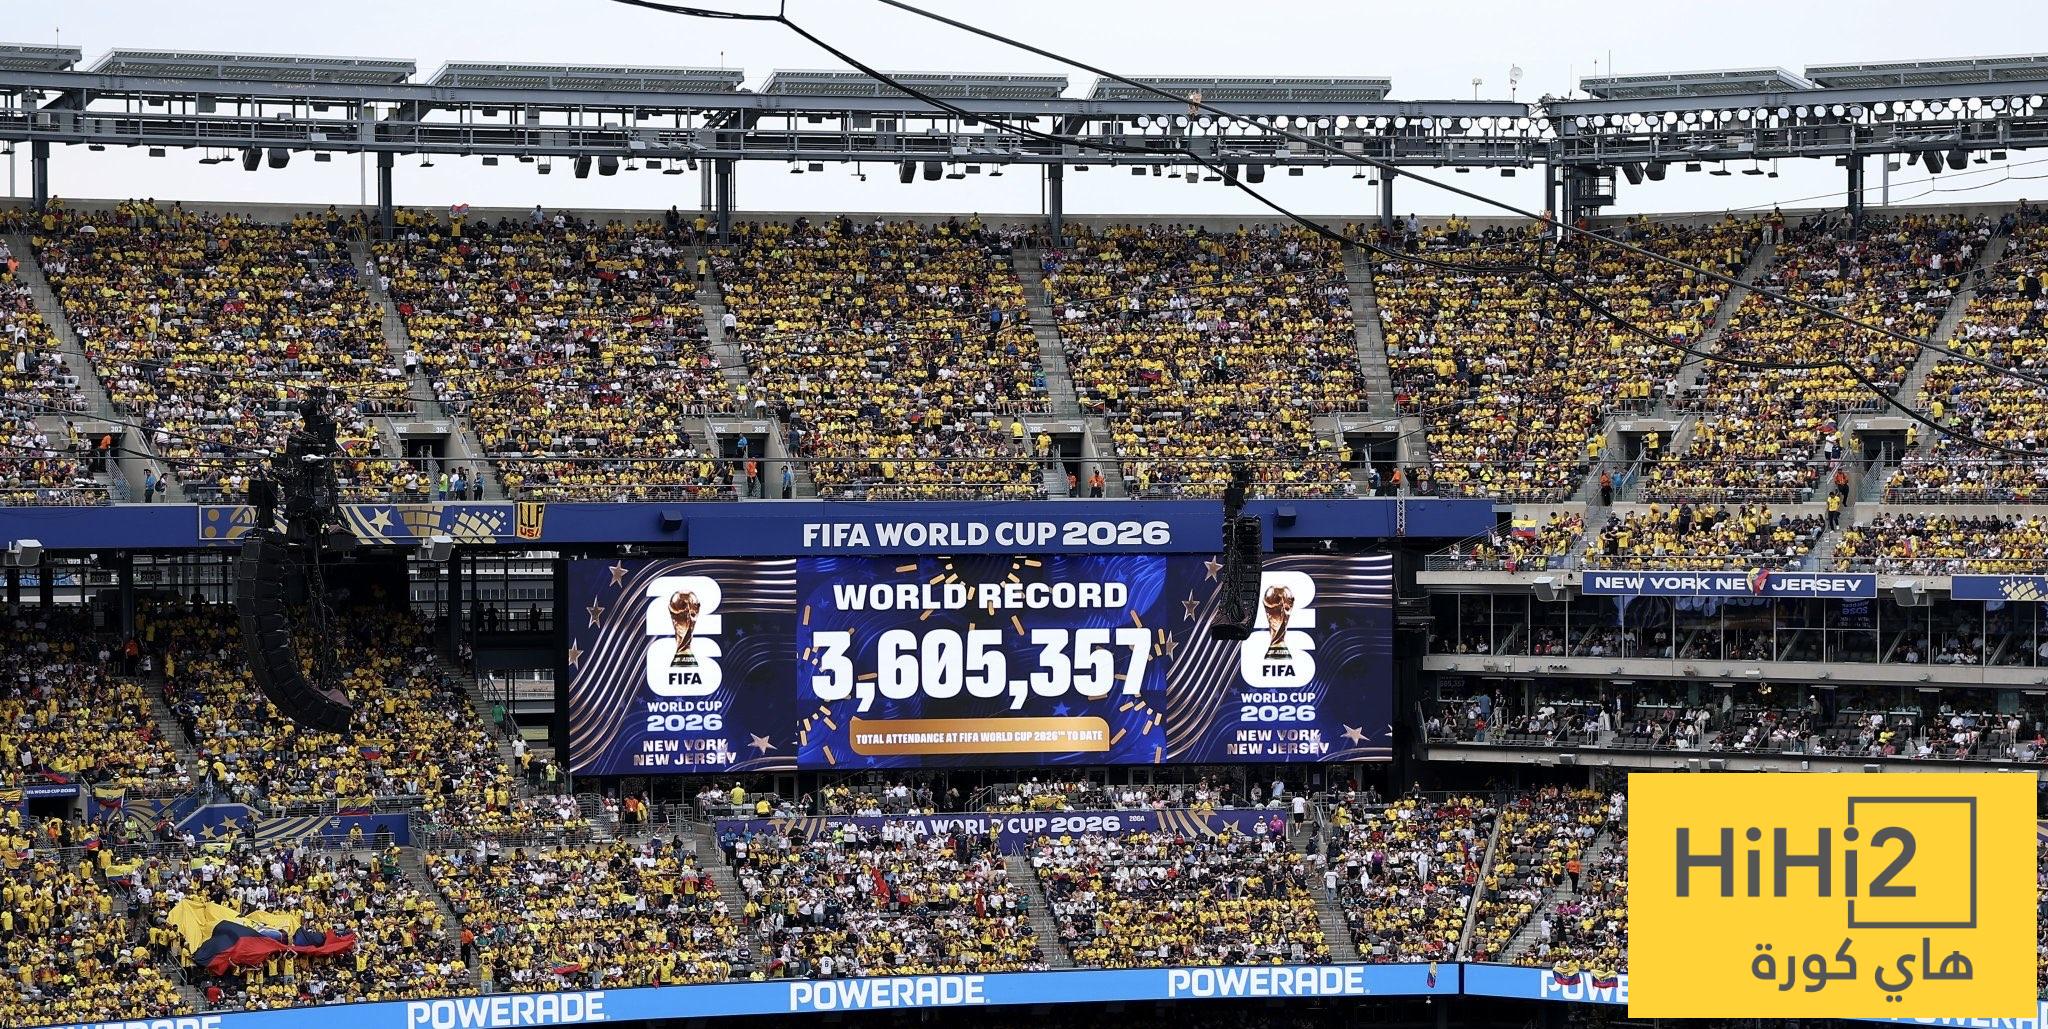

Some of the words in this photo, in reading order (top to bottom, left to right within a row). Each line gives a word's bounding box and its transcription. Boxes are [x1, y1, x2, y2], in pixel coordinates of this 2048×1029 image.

[803, 523, 871, 547] FIFA
[875, 522, 989, 547] WORLD
[994, 521, 1057, 546] CUP
[1062, 521, 1171, 545] 2026
[1595, 577, 1644, 590] NEW
[1650, 577, 1711, 590] YORK
[1771, 579, 1861, 592] JERSEY
[833, 583, 967, 611] WORLD
[979, 582, 1128, 609] RECORD
[812, 628, 1152, 713] 3,605,357
[1262, 665, 1296, 677] FIFA
[668, 673, 702, 685] FIFA
[1241, 693, 1287, 703] WORLD
[1290, 692, 1316, 703] CUP
[647, 702, 694, 712] WORLD
[697, 701, 722, 711] CUP
[1241, 705, 1316, 722] 2026
[646, 714, 723, 732] 2026
[856, 734, 884, 744] TOTAL
[886, 733, 945, 744] ATTENDANCE
[946, 733, 959, 743] AT
[959, 732, 979, 743] FIFA
[980, 732, 1014, 742] WORLD
[1014, 731, 1033, 742] CUP
[1066, 731, 1079, 741] TO
[1080, 730, 1103, 741] DATE
[1236, 730, 1272, 741] NEW
[1277, 729, 1320, 741] YORK
[643, 740, 678, 752] NEW
[684, 738, 728, 751] YORK
[1227, 743, 1262, 755] NEW
[1267, 743, 1329, 755] JERSEY
[633, 754, 674, 766] NEW
[674, 752, 737, 765] JERSEY
[1008, 818, 1047, 834] CUP
[1050, 816, 1121, 834] 2026
